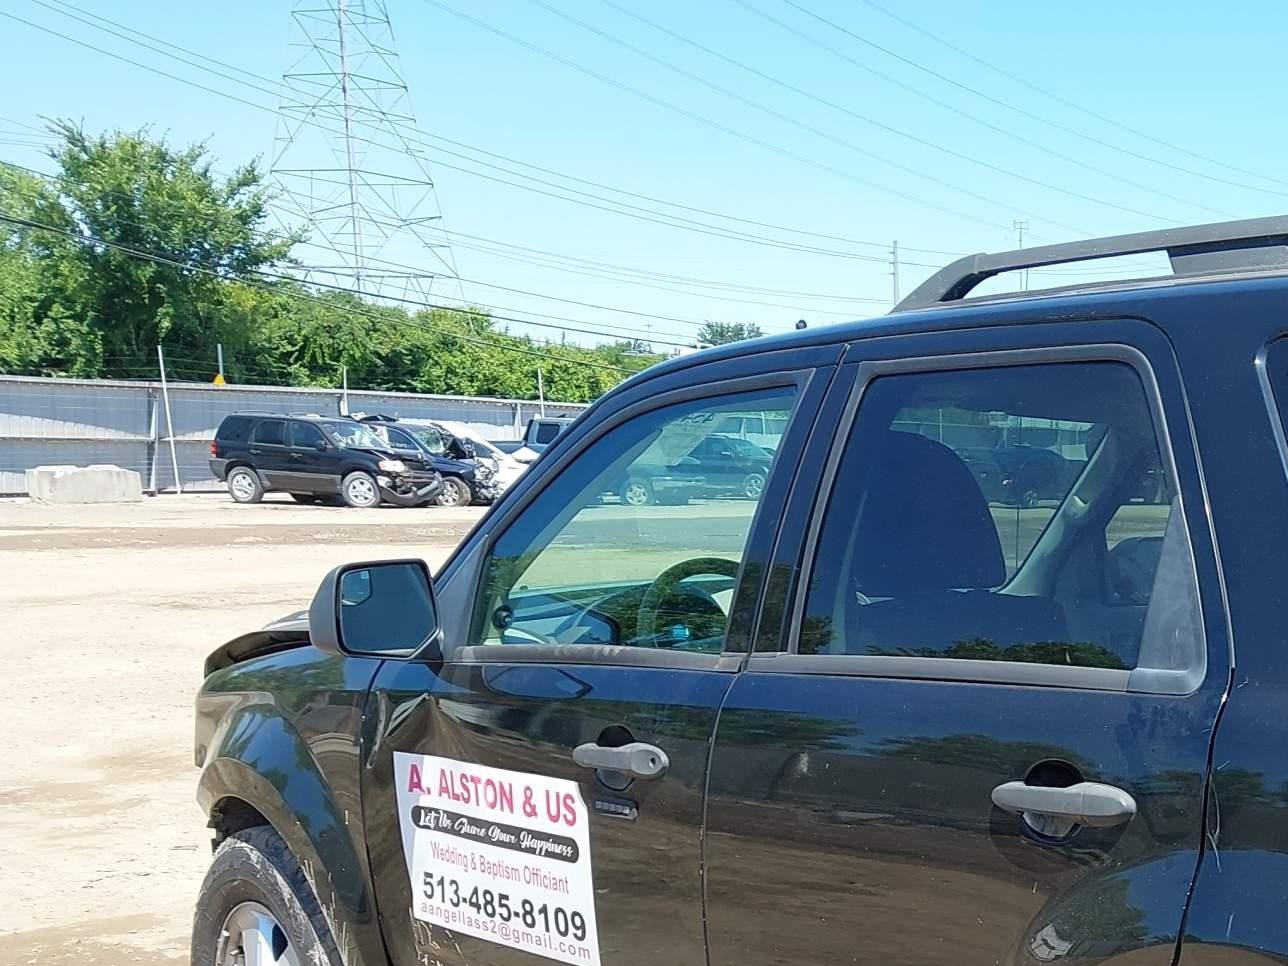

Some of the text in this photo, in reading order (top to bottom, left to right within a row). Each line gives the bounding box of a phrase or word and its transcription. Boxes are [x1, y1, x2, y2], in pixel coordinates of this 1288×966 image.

[408, 764, 431, 795] A.
[438, 768, 514, 814] ALSTON
[522, 785, 538, 818] &
[545, 789, 577, 827] US
[418, 809, 436, 829] Let
[488, 824, 518, 844] Your
[519, 830, 575, 858] Happiness
[430, 840, 570, 895] Wedding & Baptism Officiant
[421, 901, 592, 960] aangellass2@gmail.com
[423, 871, 587, 942] 513-485-8109
